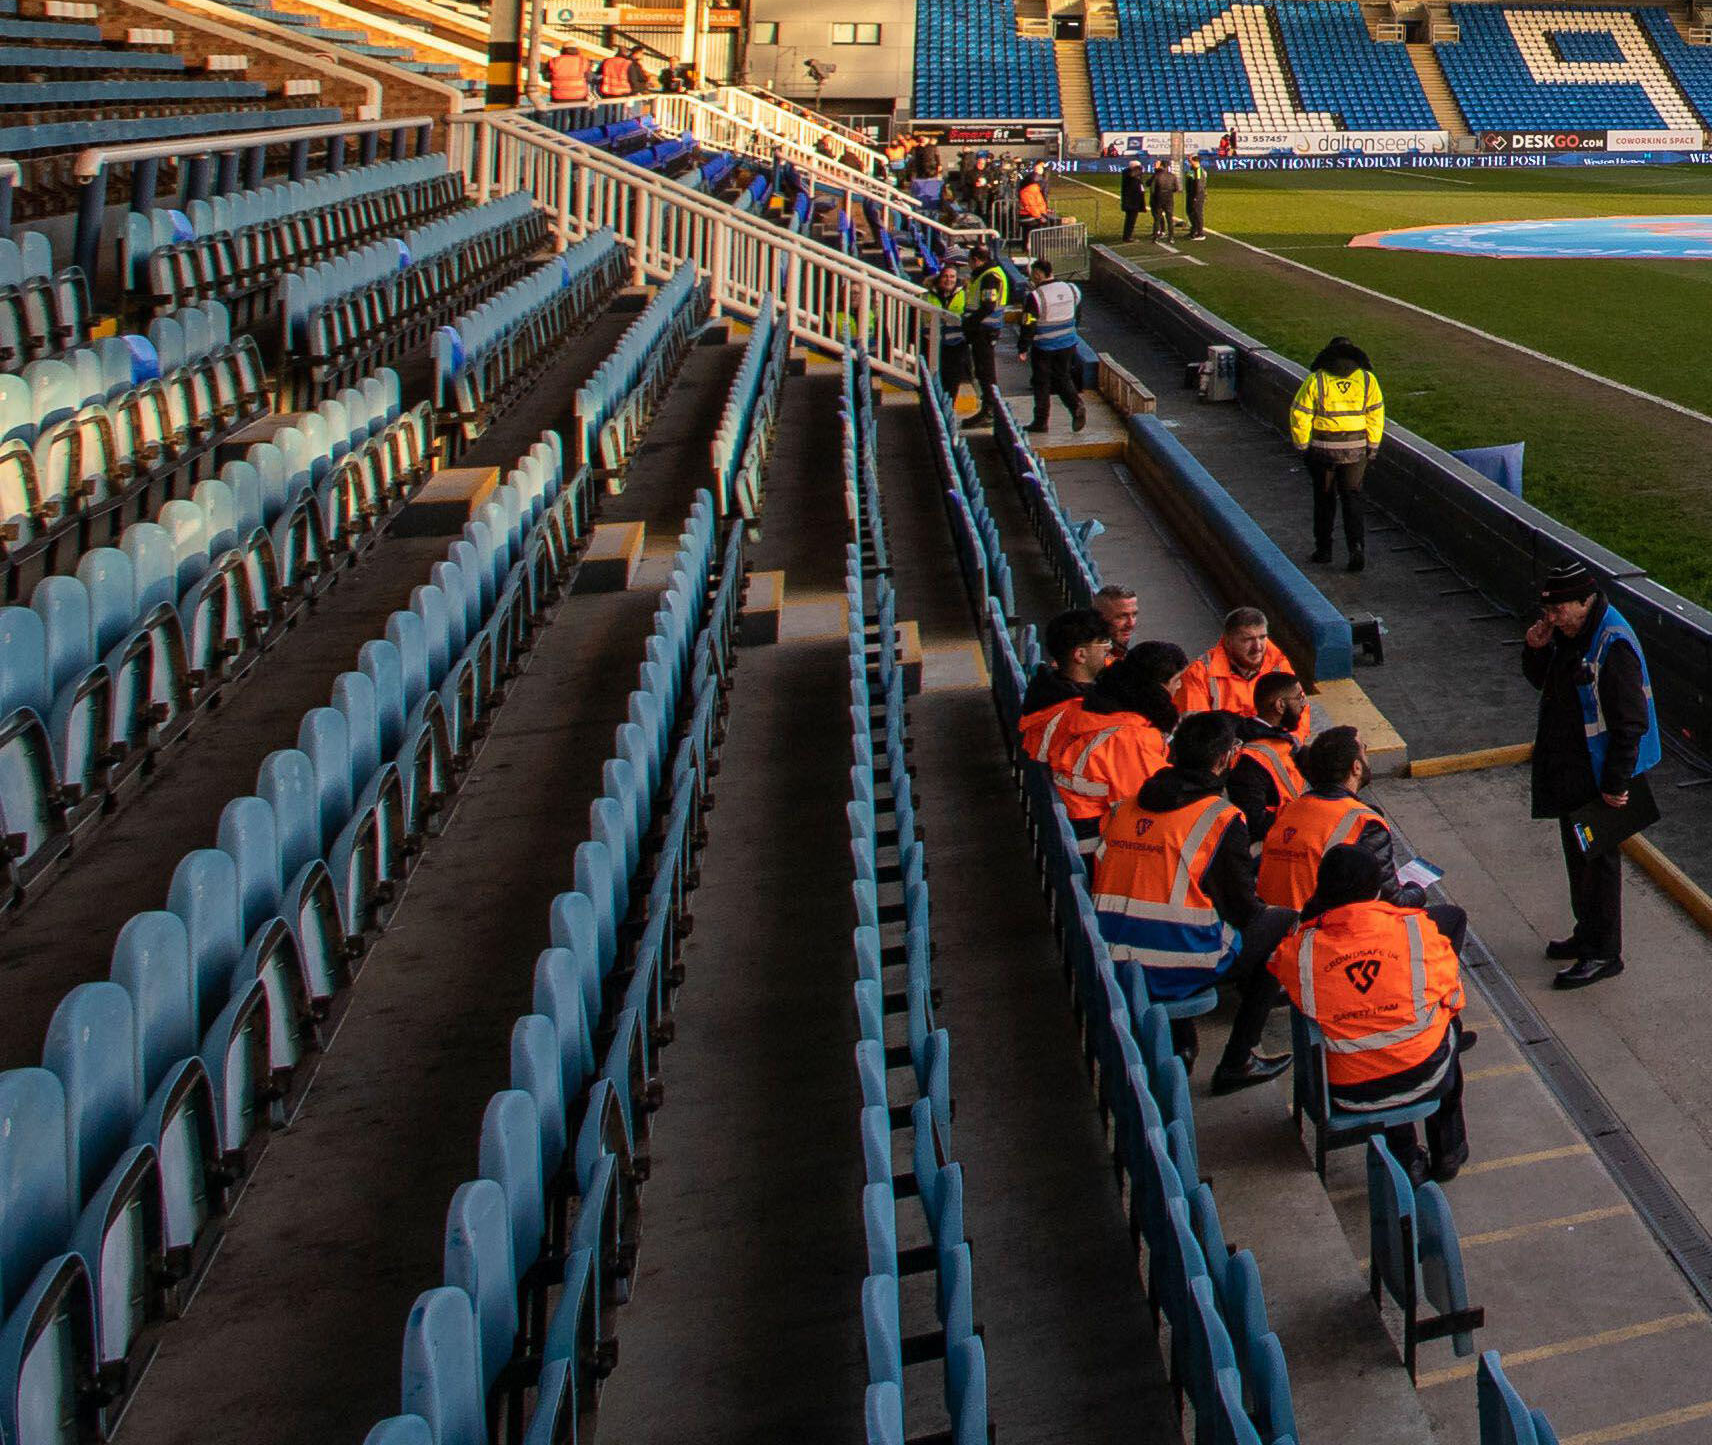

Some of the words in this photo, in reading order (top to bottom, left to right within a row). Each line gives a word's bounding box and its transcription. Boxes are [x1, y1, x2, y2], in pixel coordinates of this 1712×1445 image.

[1512, 135, 1604, 149] DESKGO.COM
[1616, 137, 1668, 145] COWORKING
[1669, 137, 1695, 145] SPACE
[1215, 158, 1278, 171] WESTON
[1281, 157, 1334, 170] HOMES
[1336, 156, 1401, 169] STADIUM
[1411, 156, 1453, 168] HOME
[1456, 156, 1475, 168] OF
[1477, 155, 1508, 167] THE
[1509, 155, 1547, 167] POSH
